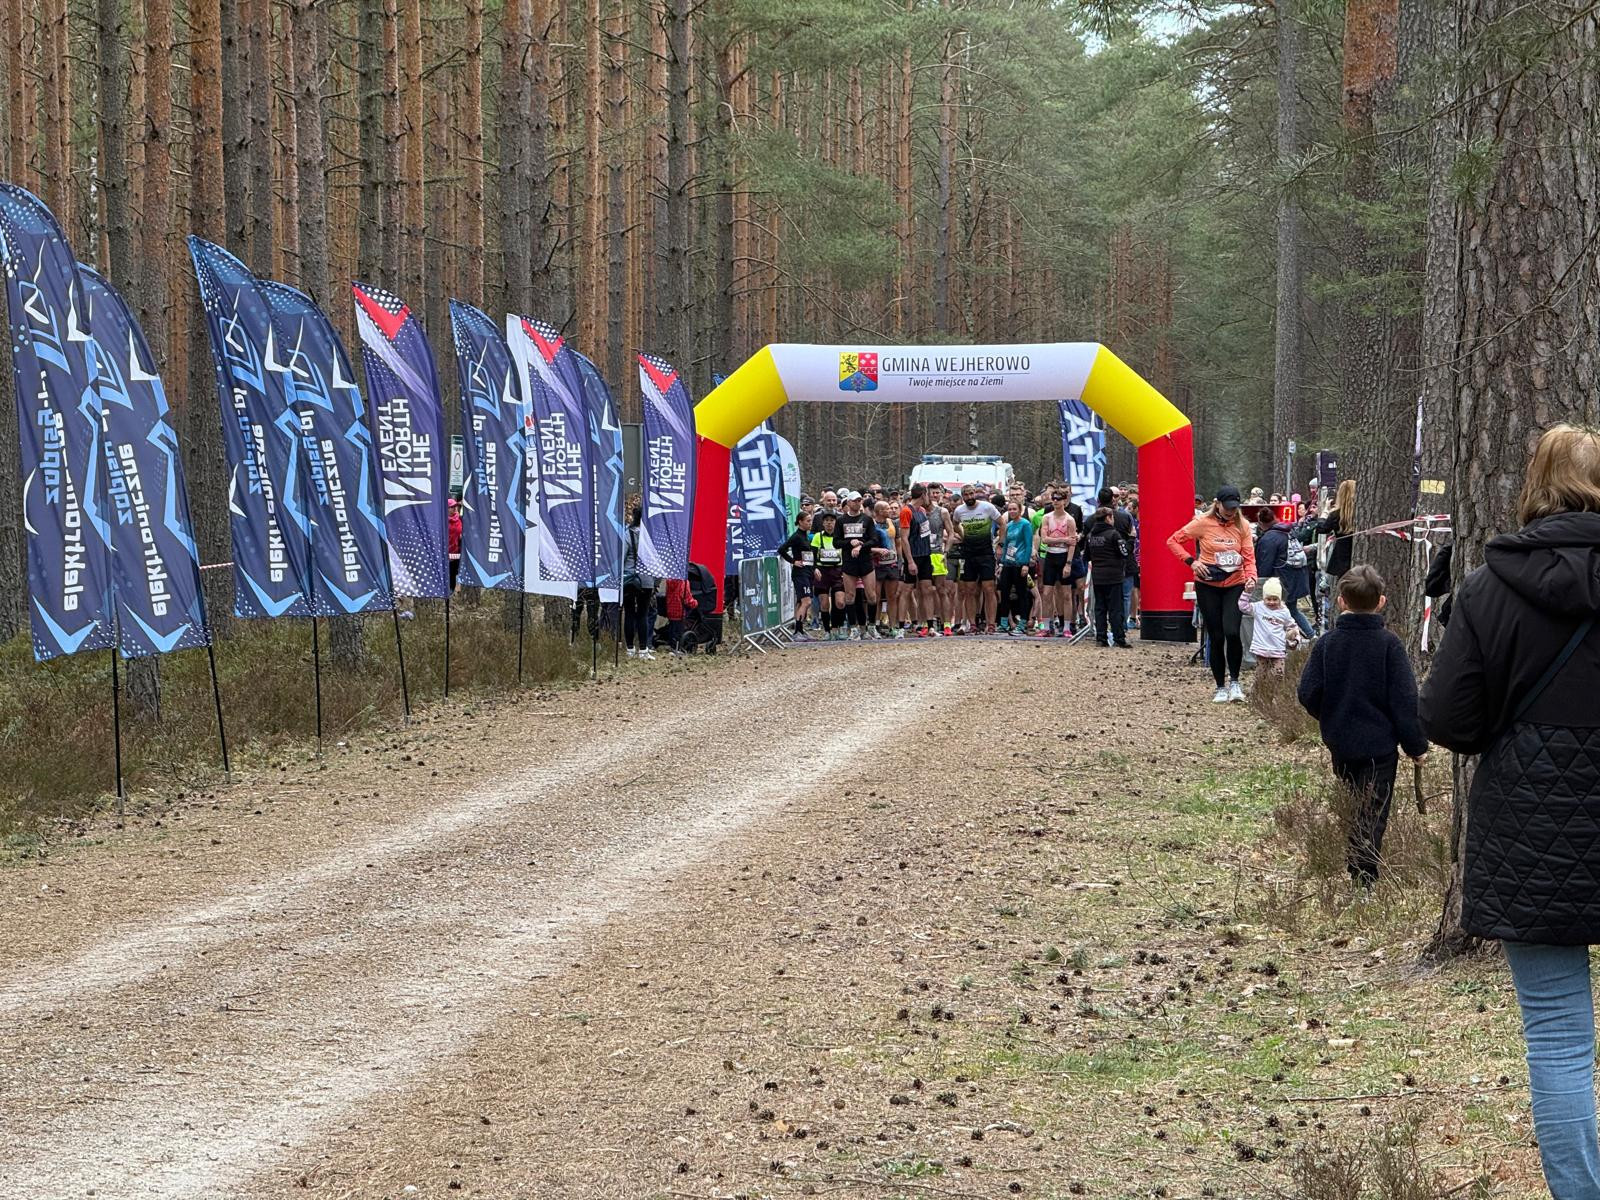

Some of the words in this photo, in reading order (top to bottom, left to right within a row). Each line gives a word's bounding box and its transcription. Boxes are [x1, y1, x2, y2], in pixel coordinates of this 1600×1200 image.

[882, 357, 930, 372] GMINA
[935, 355, 1030, 372] WEJHEROWO
[908, 377, 934, 388] Twoje
[935, 376, 966, 388] miejsce
[967, 378, 979, 386] na
[980, 375, 1004, 386] Ziemi
[1219, 555, 1240, 566] 587
[803, 586, 811, 594] 16
